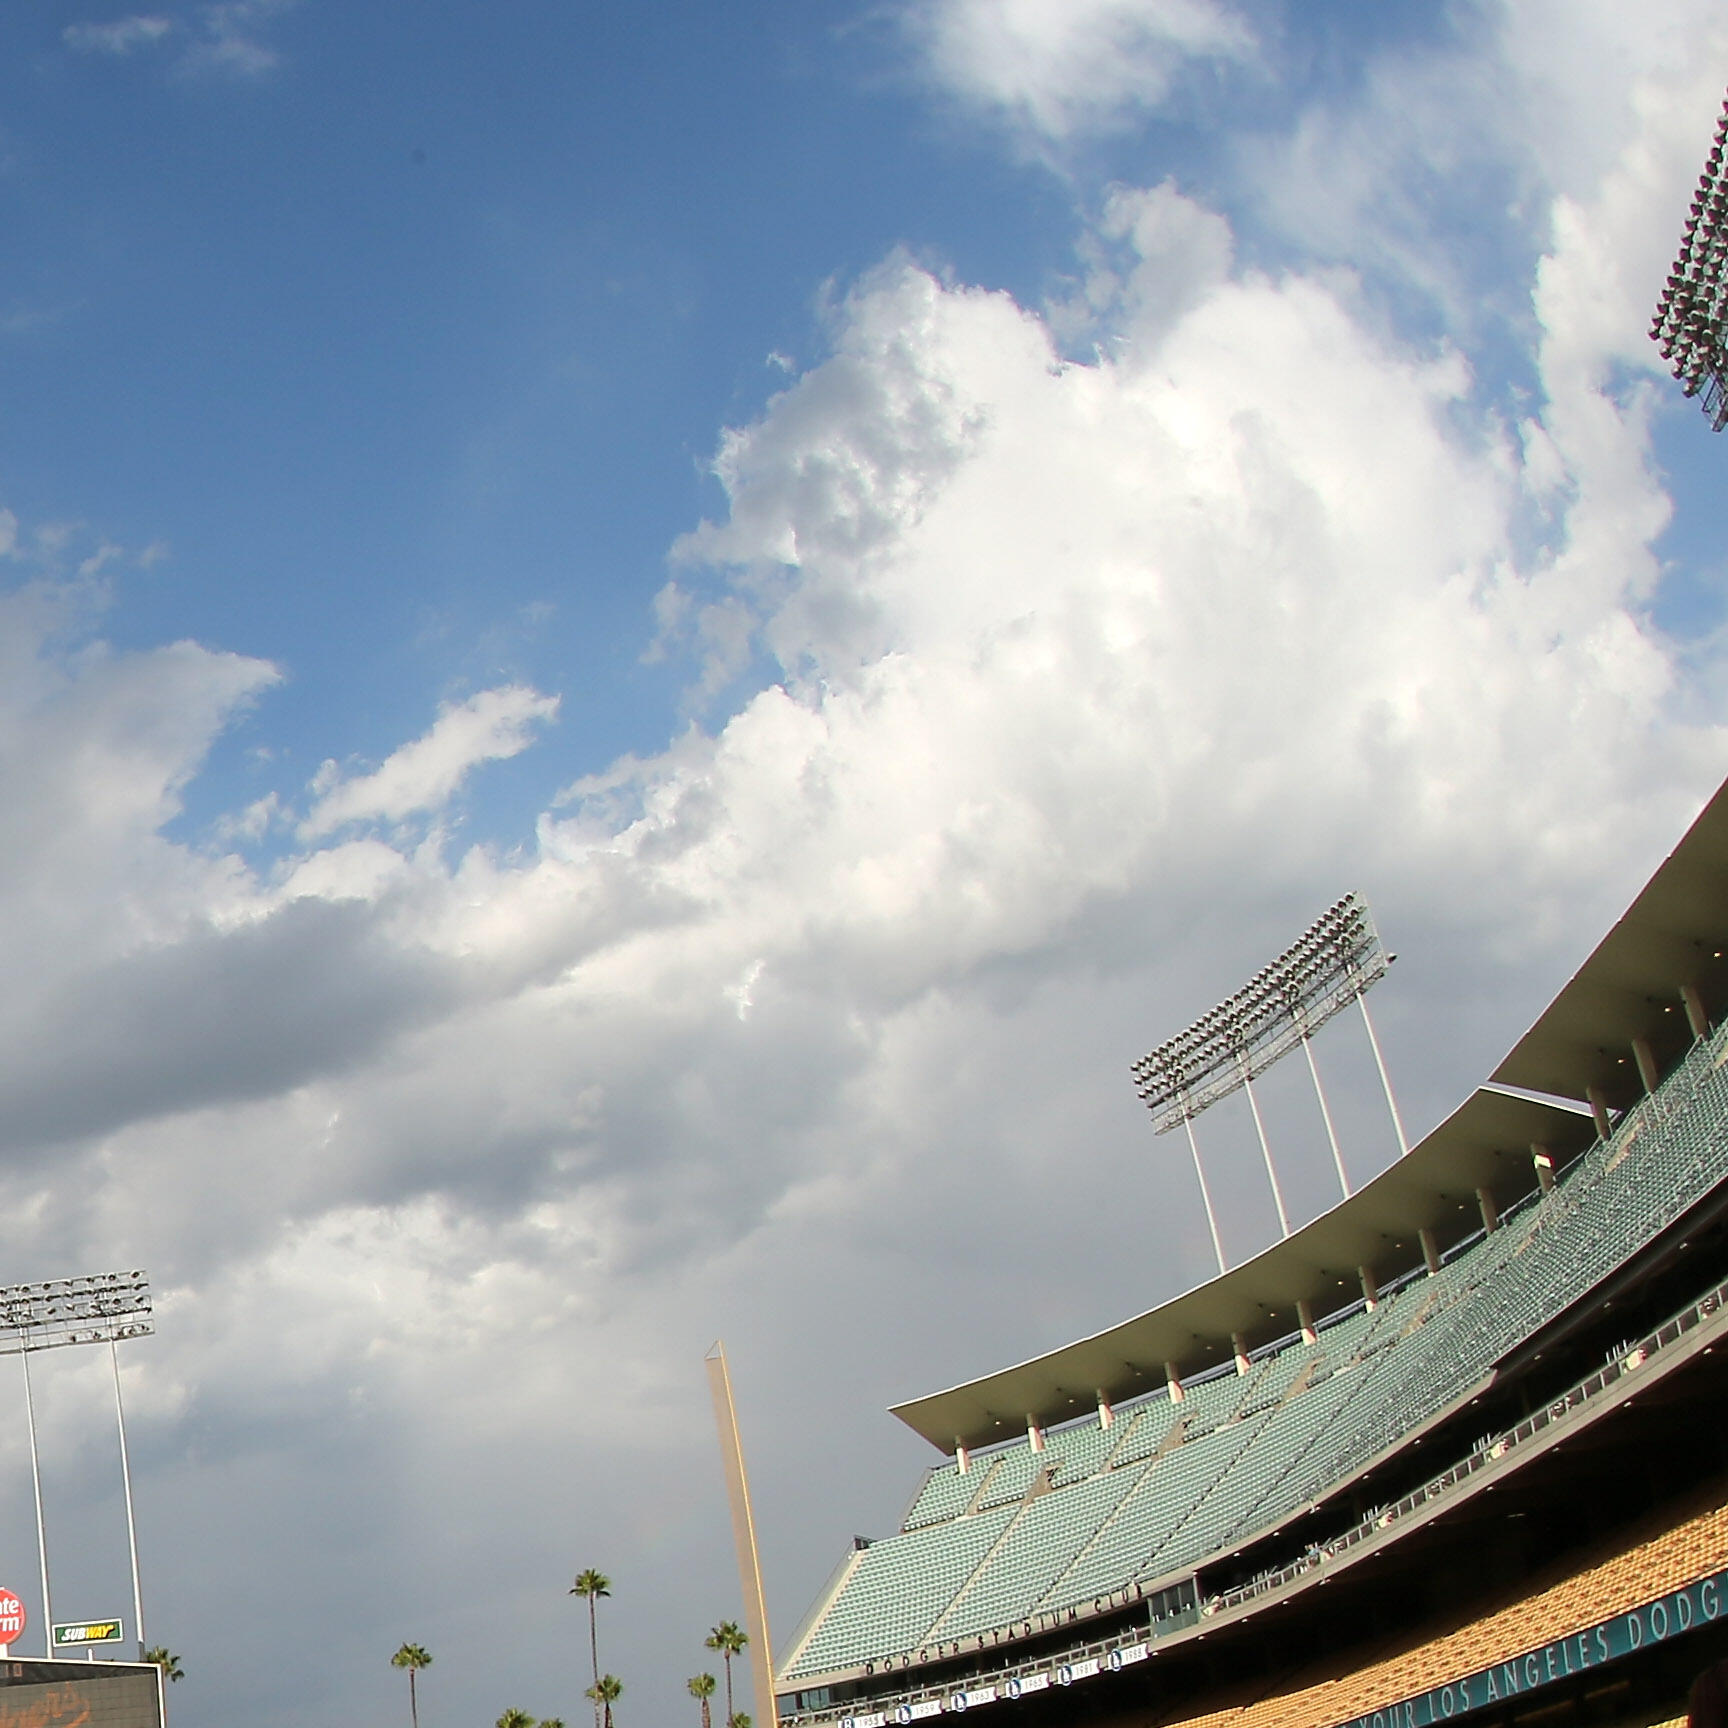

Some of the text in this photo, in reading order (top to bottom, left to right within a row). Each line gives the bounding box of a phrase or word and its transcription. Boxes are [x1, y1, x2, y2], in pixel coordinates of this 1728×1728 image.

[60, 1624, 117, 1641] SUBWAY
[866, 1584, 1142, 1675] DODGER STADIUM CLUB
[1124, 1648, 1143, 1661] 1988
[1428, 1679, 1471, 1722] LOS
[1486, 1625, 1608, 1702] ANGELES
[1626, 1578, 1728, 1650] DODG
[1075, 1662, 1093, 1675] 1981
[1024, 1677, 1043, 1689] 1965
[970, 1691, 990, 1702] 1963
